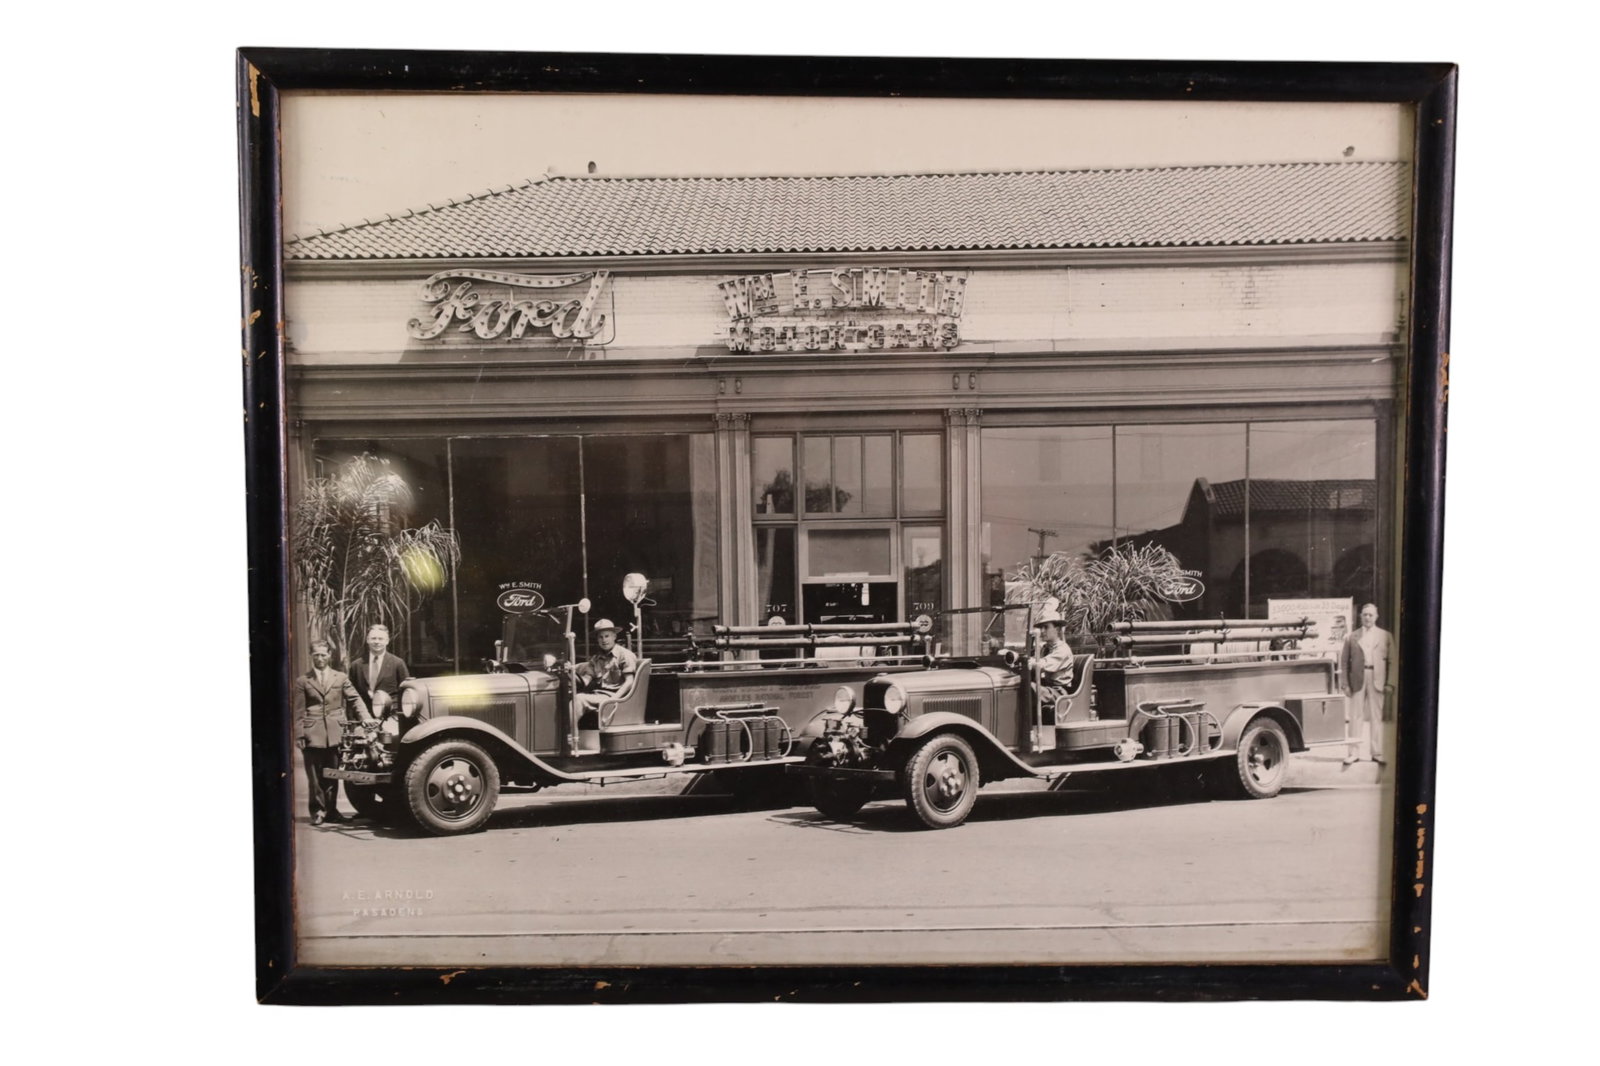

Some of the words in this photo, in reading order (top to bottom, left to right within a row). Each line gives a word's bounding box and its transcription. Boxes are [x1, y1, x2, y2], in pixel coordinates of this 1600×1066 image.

[831, 267, 966, 318] SMITH
[407, 268, 609, 340] Ford
[729, 324, 846, 350] MOTOR
[867, 322, 959, 348] CARS
[519, 581, 542, 590] SMITH
[1165, 581, 1196, 595] Ford
[504, 593, 536, 607] Ford
[766, 604, 787, 612] 707
[375, 889, 434, 900] ARNOLD
